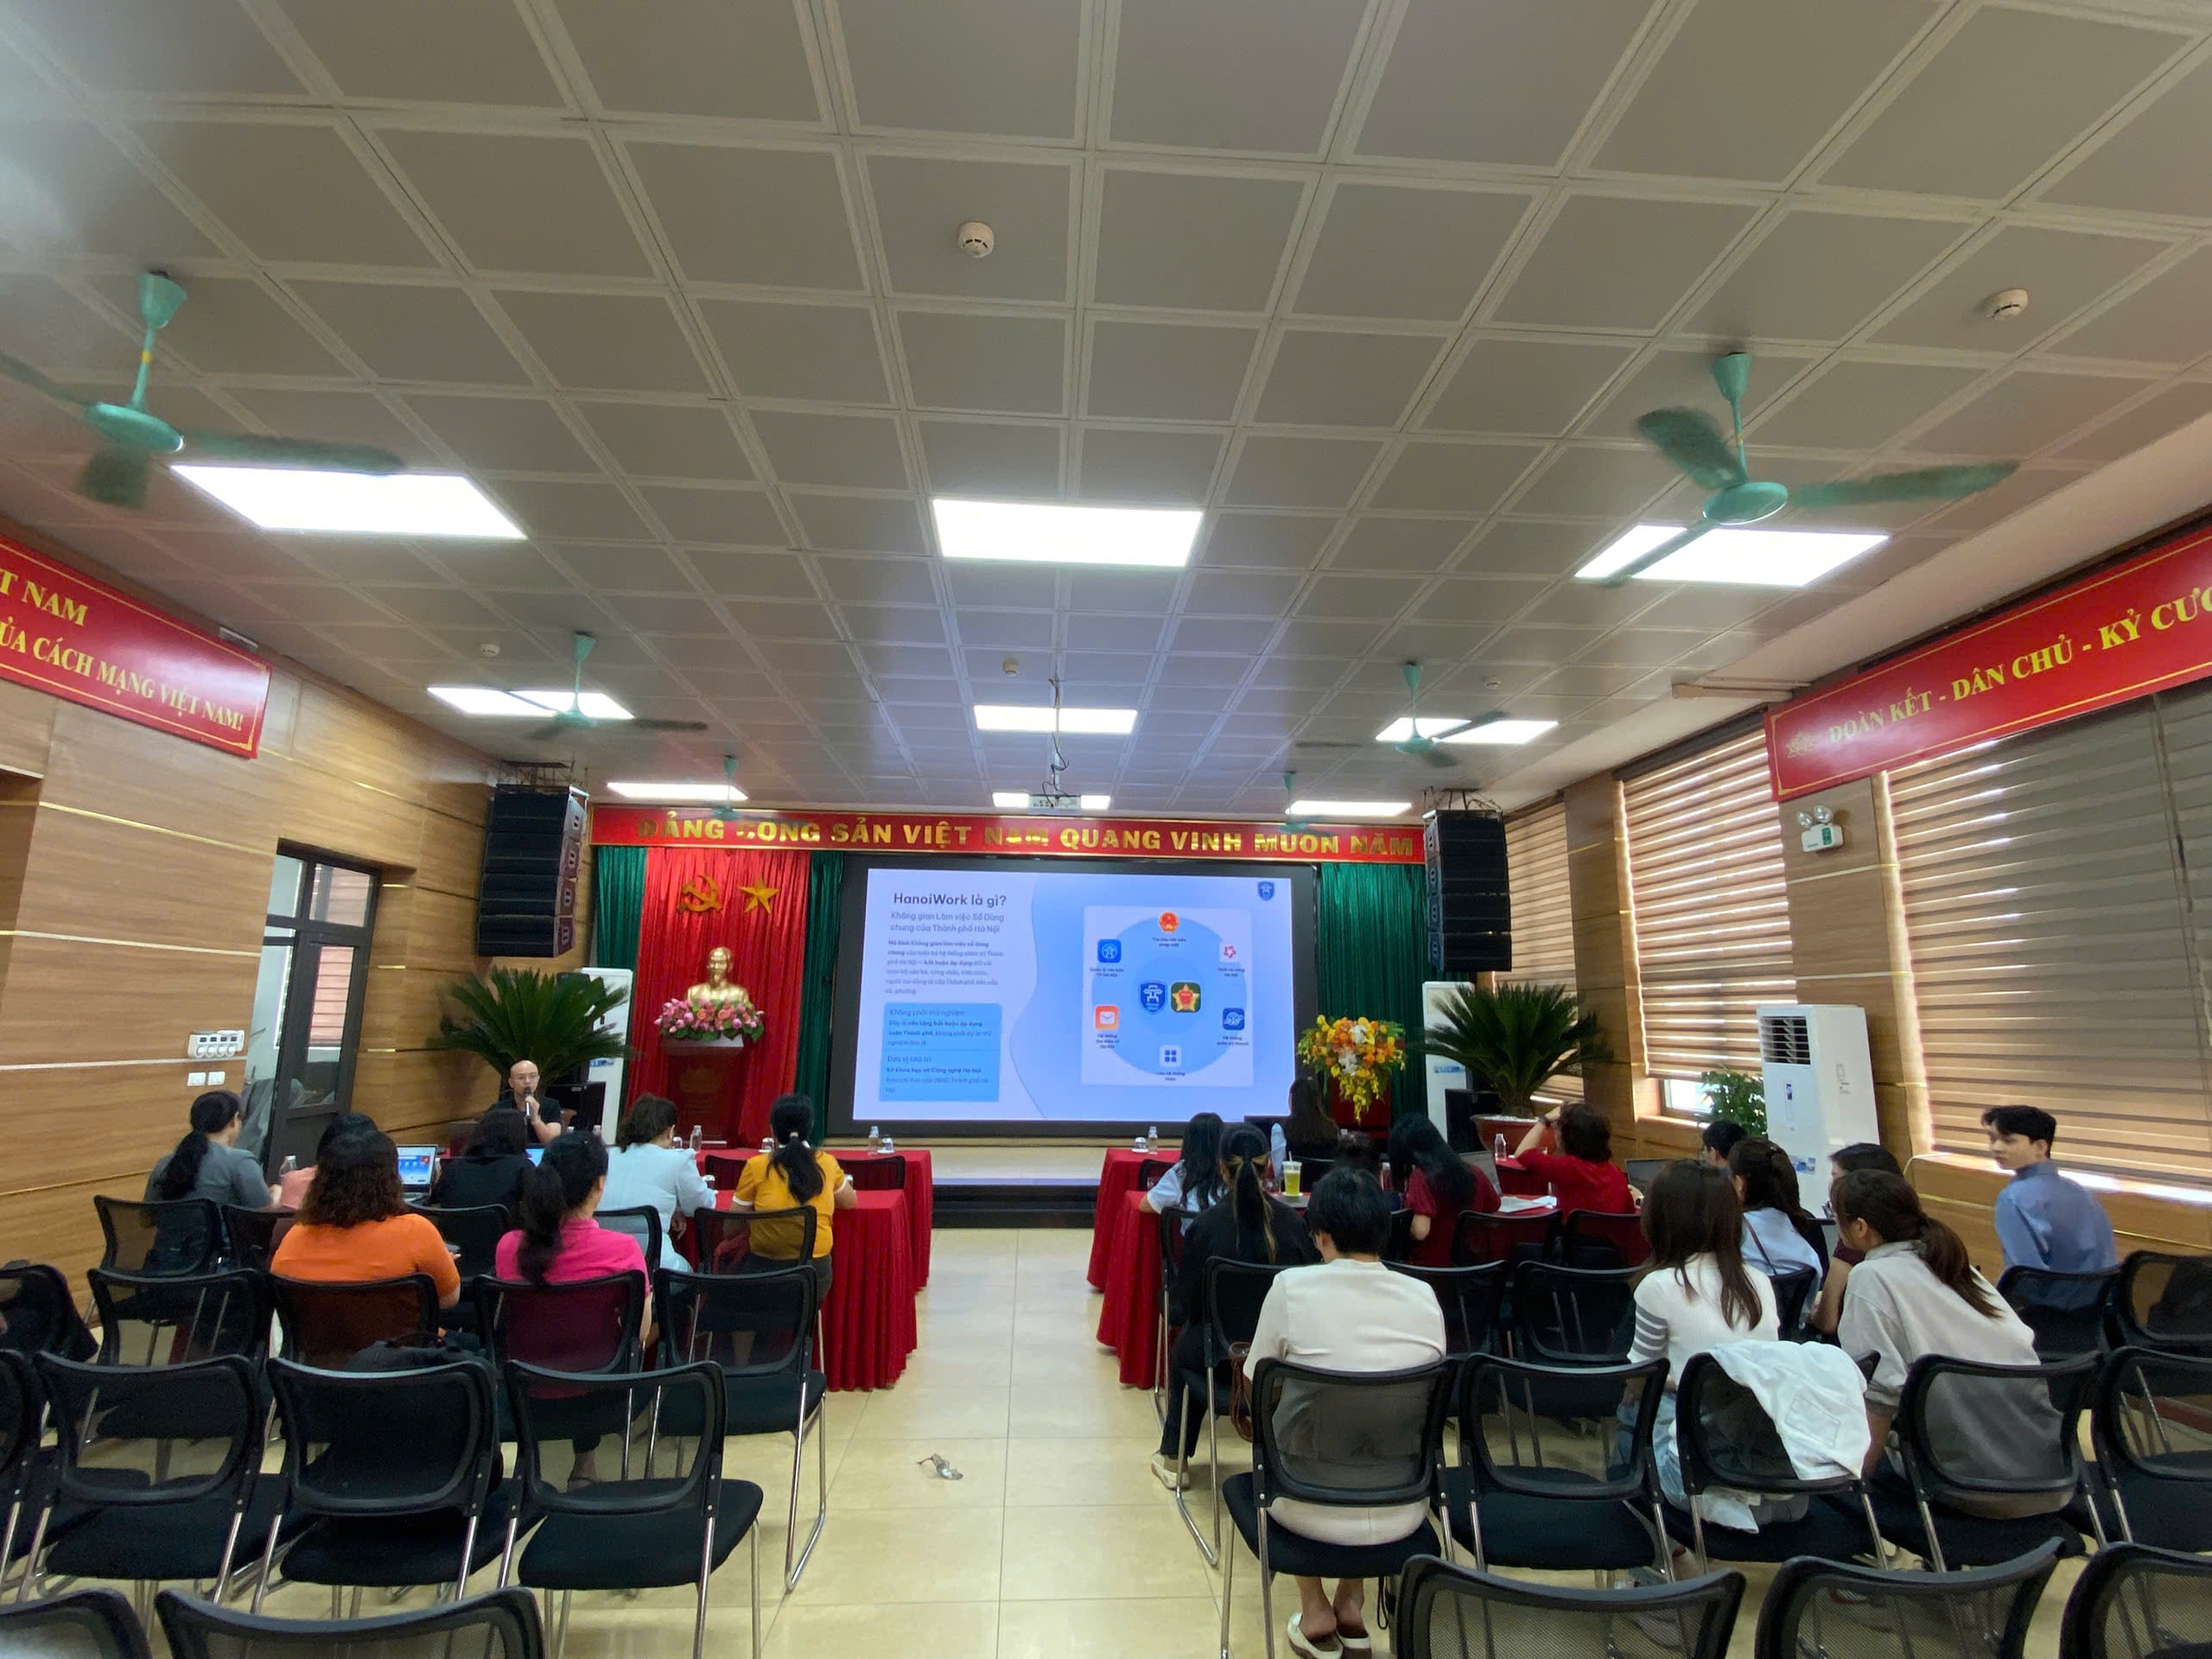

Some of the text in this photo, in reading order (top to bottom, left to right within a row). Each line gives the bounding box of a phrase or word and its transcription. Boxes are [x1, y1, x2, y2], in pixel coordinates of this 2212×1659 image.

[21, 579, 89, 626] NAM
[33, 637, 94, 677] CÁCH
[97, 660, 155, 699] MẠNG
[160, 683, 200, 717] VIỆT
[201, 701, 244, 732] NAM!
[1827, 709, 1885, 744] ĐOÀN
[1889, 687, 1933, 723] KẾT
[1951, 664, 2005, 702] DÂN
[2012, 633, 2074, 679] CHỦ
[2098, 607, 2142, 652] KỶ
[637, 810, 724, 841] ĐẢNG
[830, 817, 892, 843] SẢN
[903, 820, 972, 849] VIỆT
[984, 826, 1049, 847] NAM
[1059, 828, 1160, 850] QUANG
[1170, 830, 1242, 852] VINH
[1350, 832, 1414, 856] NĂM
[891, 912, 917, 922] Không
[918, 912, 935, 922] gian
[893, 893, 1007, 908] HanoiWork là gì?
[890, 924, 914, 933] chung
[987, 925, 1000, 934] Nội
